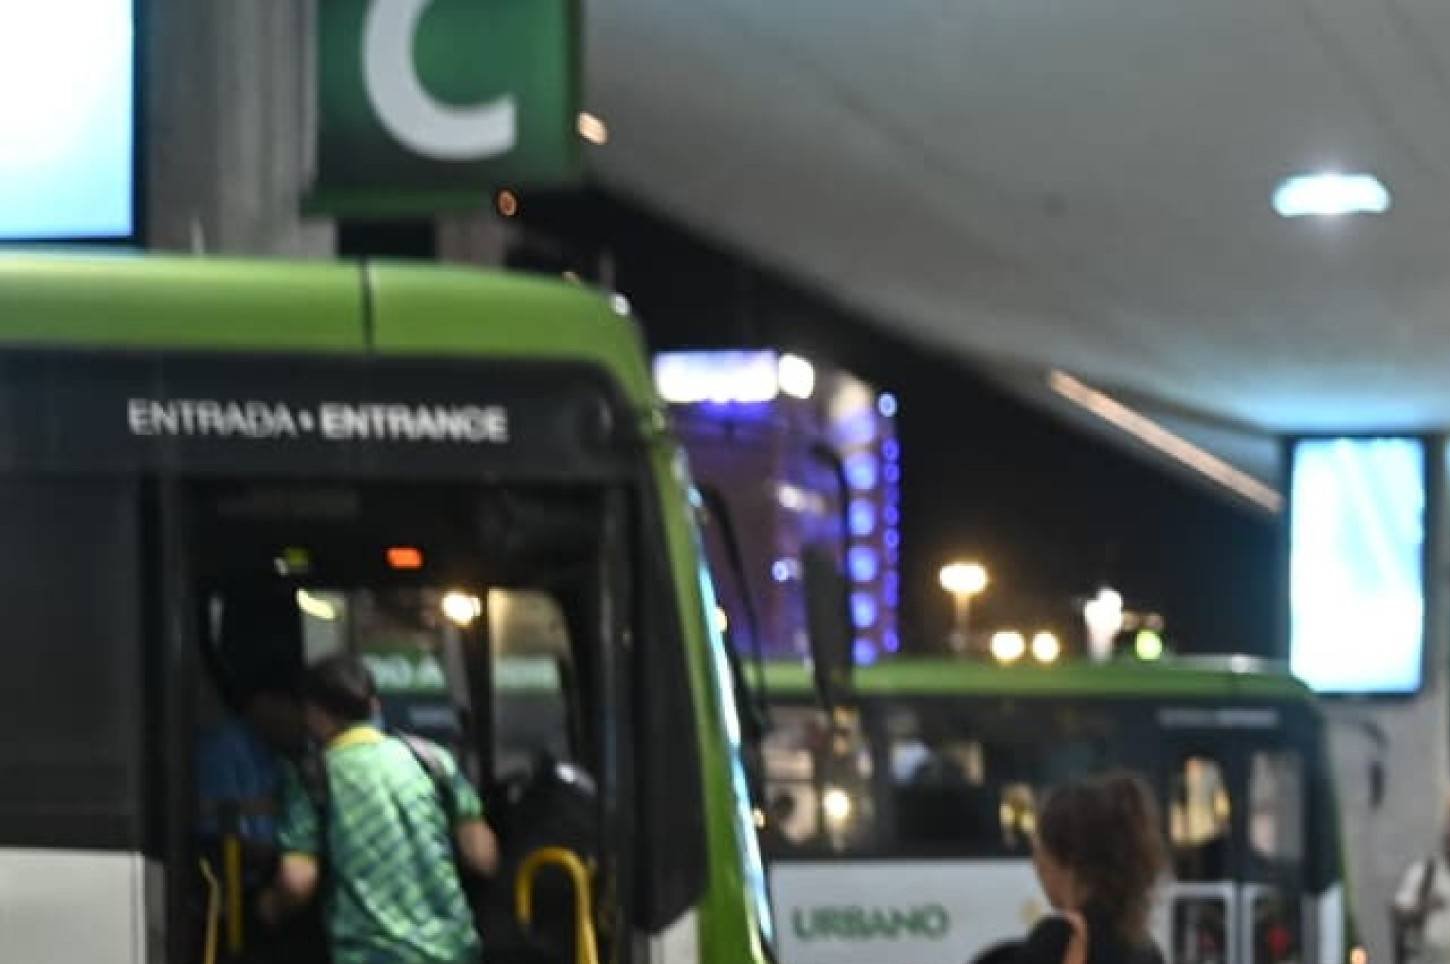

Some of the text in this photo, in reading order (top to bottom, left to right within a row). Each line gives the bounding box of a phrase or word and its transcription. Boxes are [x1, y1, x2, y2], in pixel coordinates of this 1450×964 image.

[363, 0, 517, 159] C
[128, 399, 509, 443] ENTRADA ENTRANCE
[791, 902, 949, 942] URBANO
